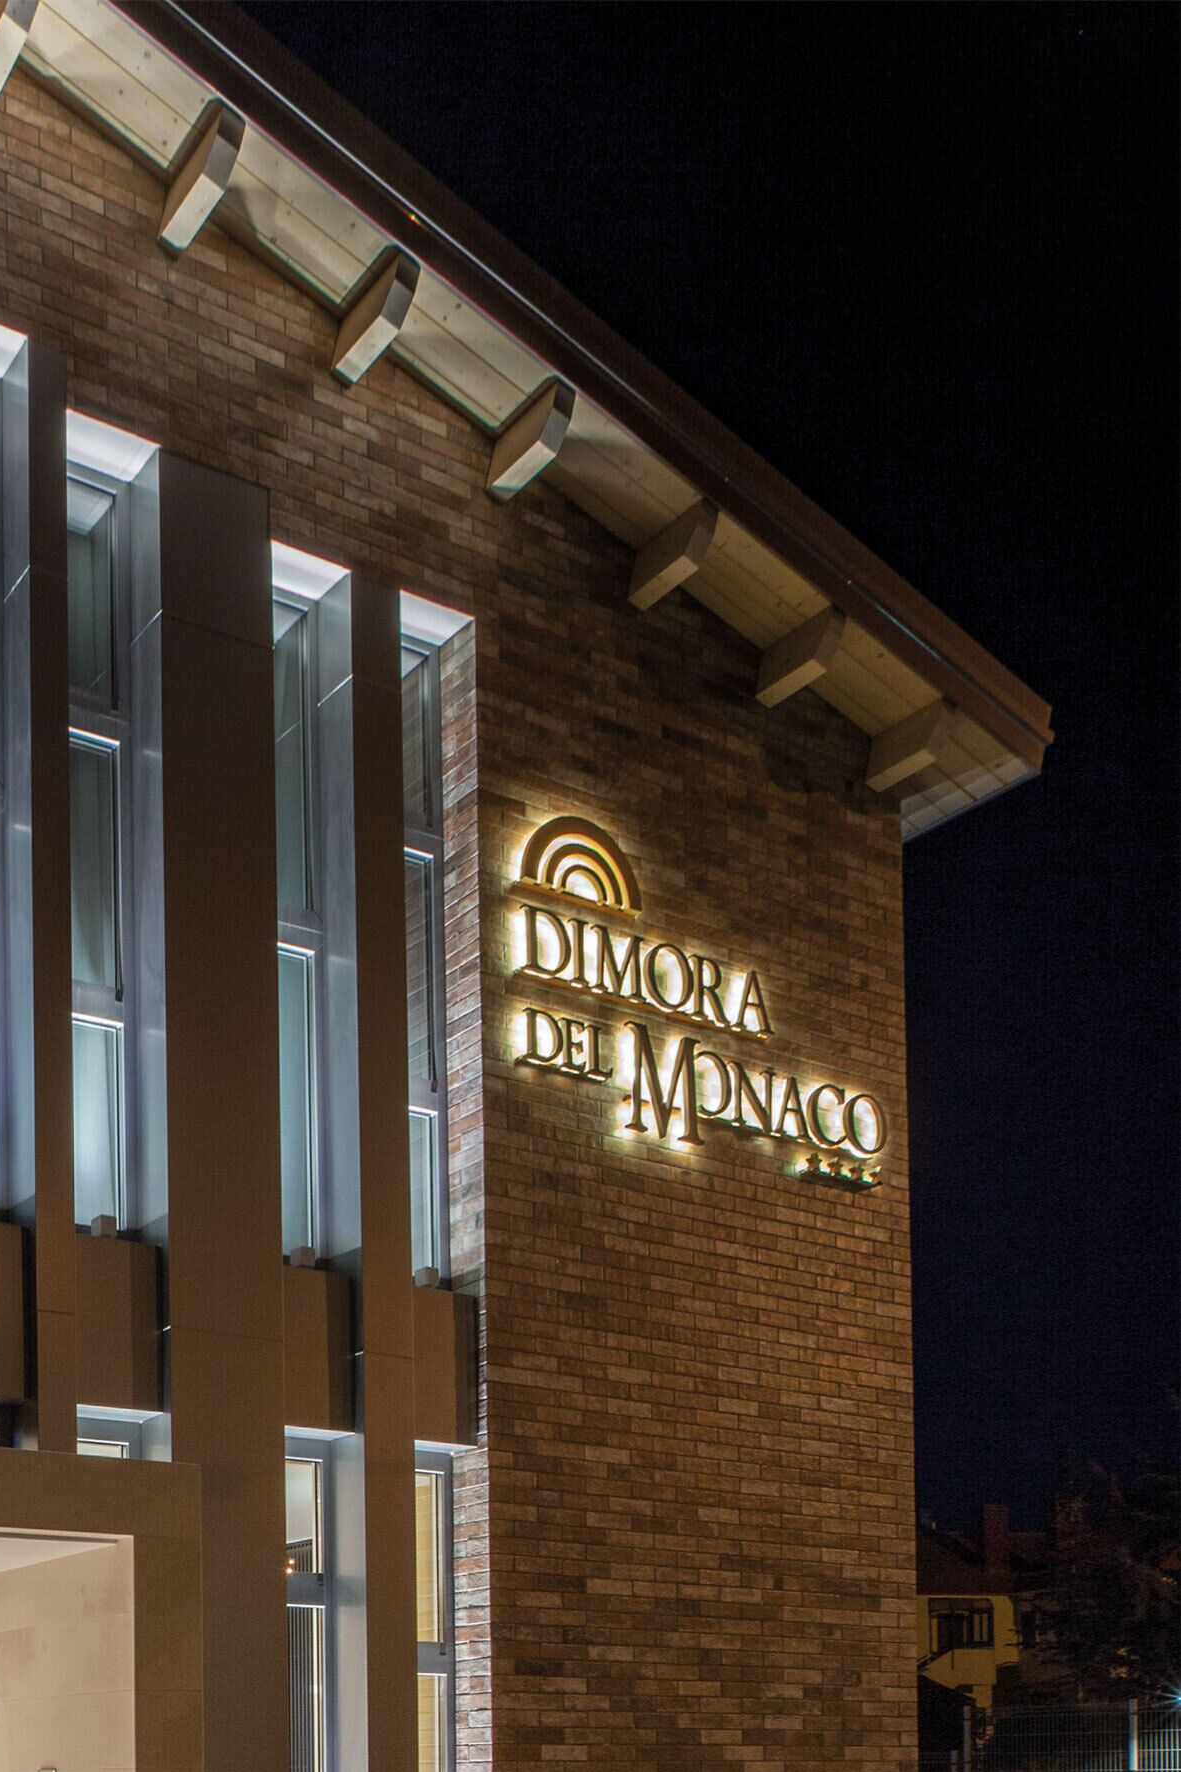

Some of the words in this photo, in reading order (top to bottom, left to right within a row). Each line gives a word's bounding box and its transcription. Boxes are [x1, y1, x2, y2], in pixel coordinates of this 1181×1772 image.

[519, 904, 774, 1038] DIMORA
[520, 1007, 614, 1080] DEL
[623, 1021, 888, 1155] MONACO
